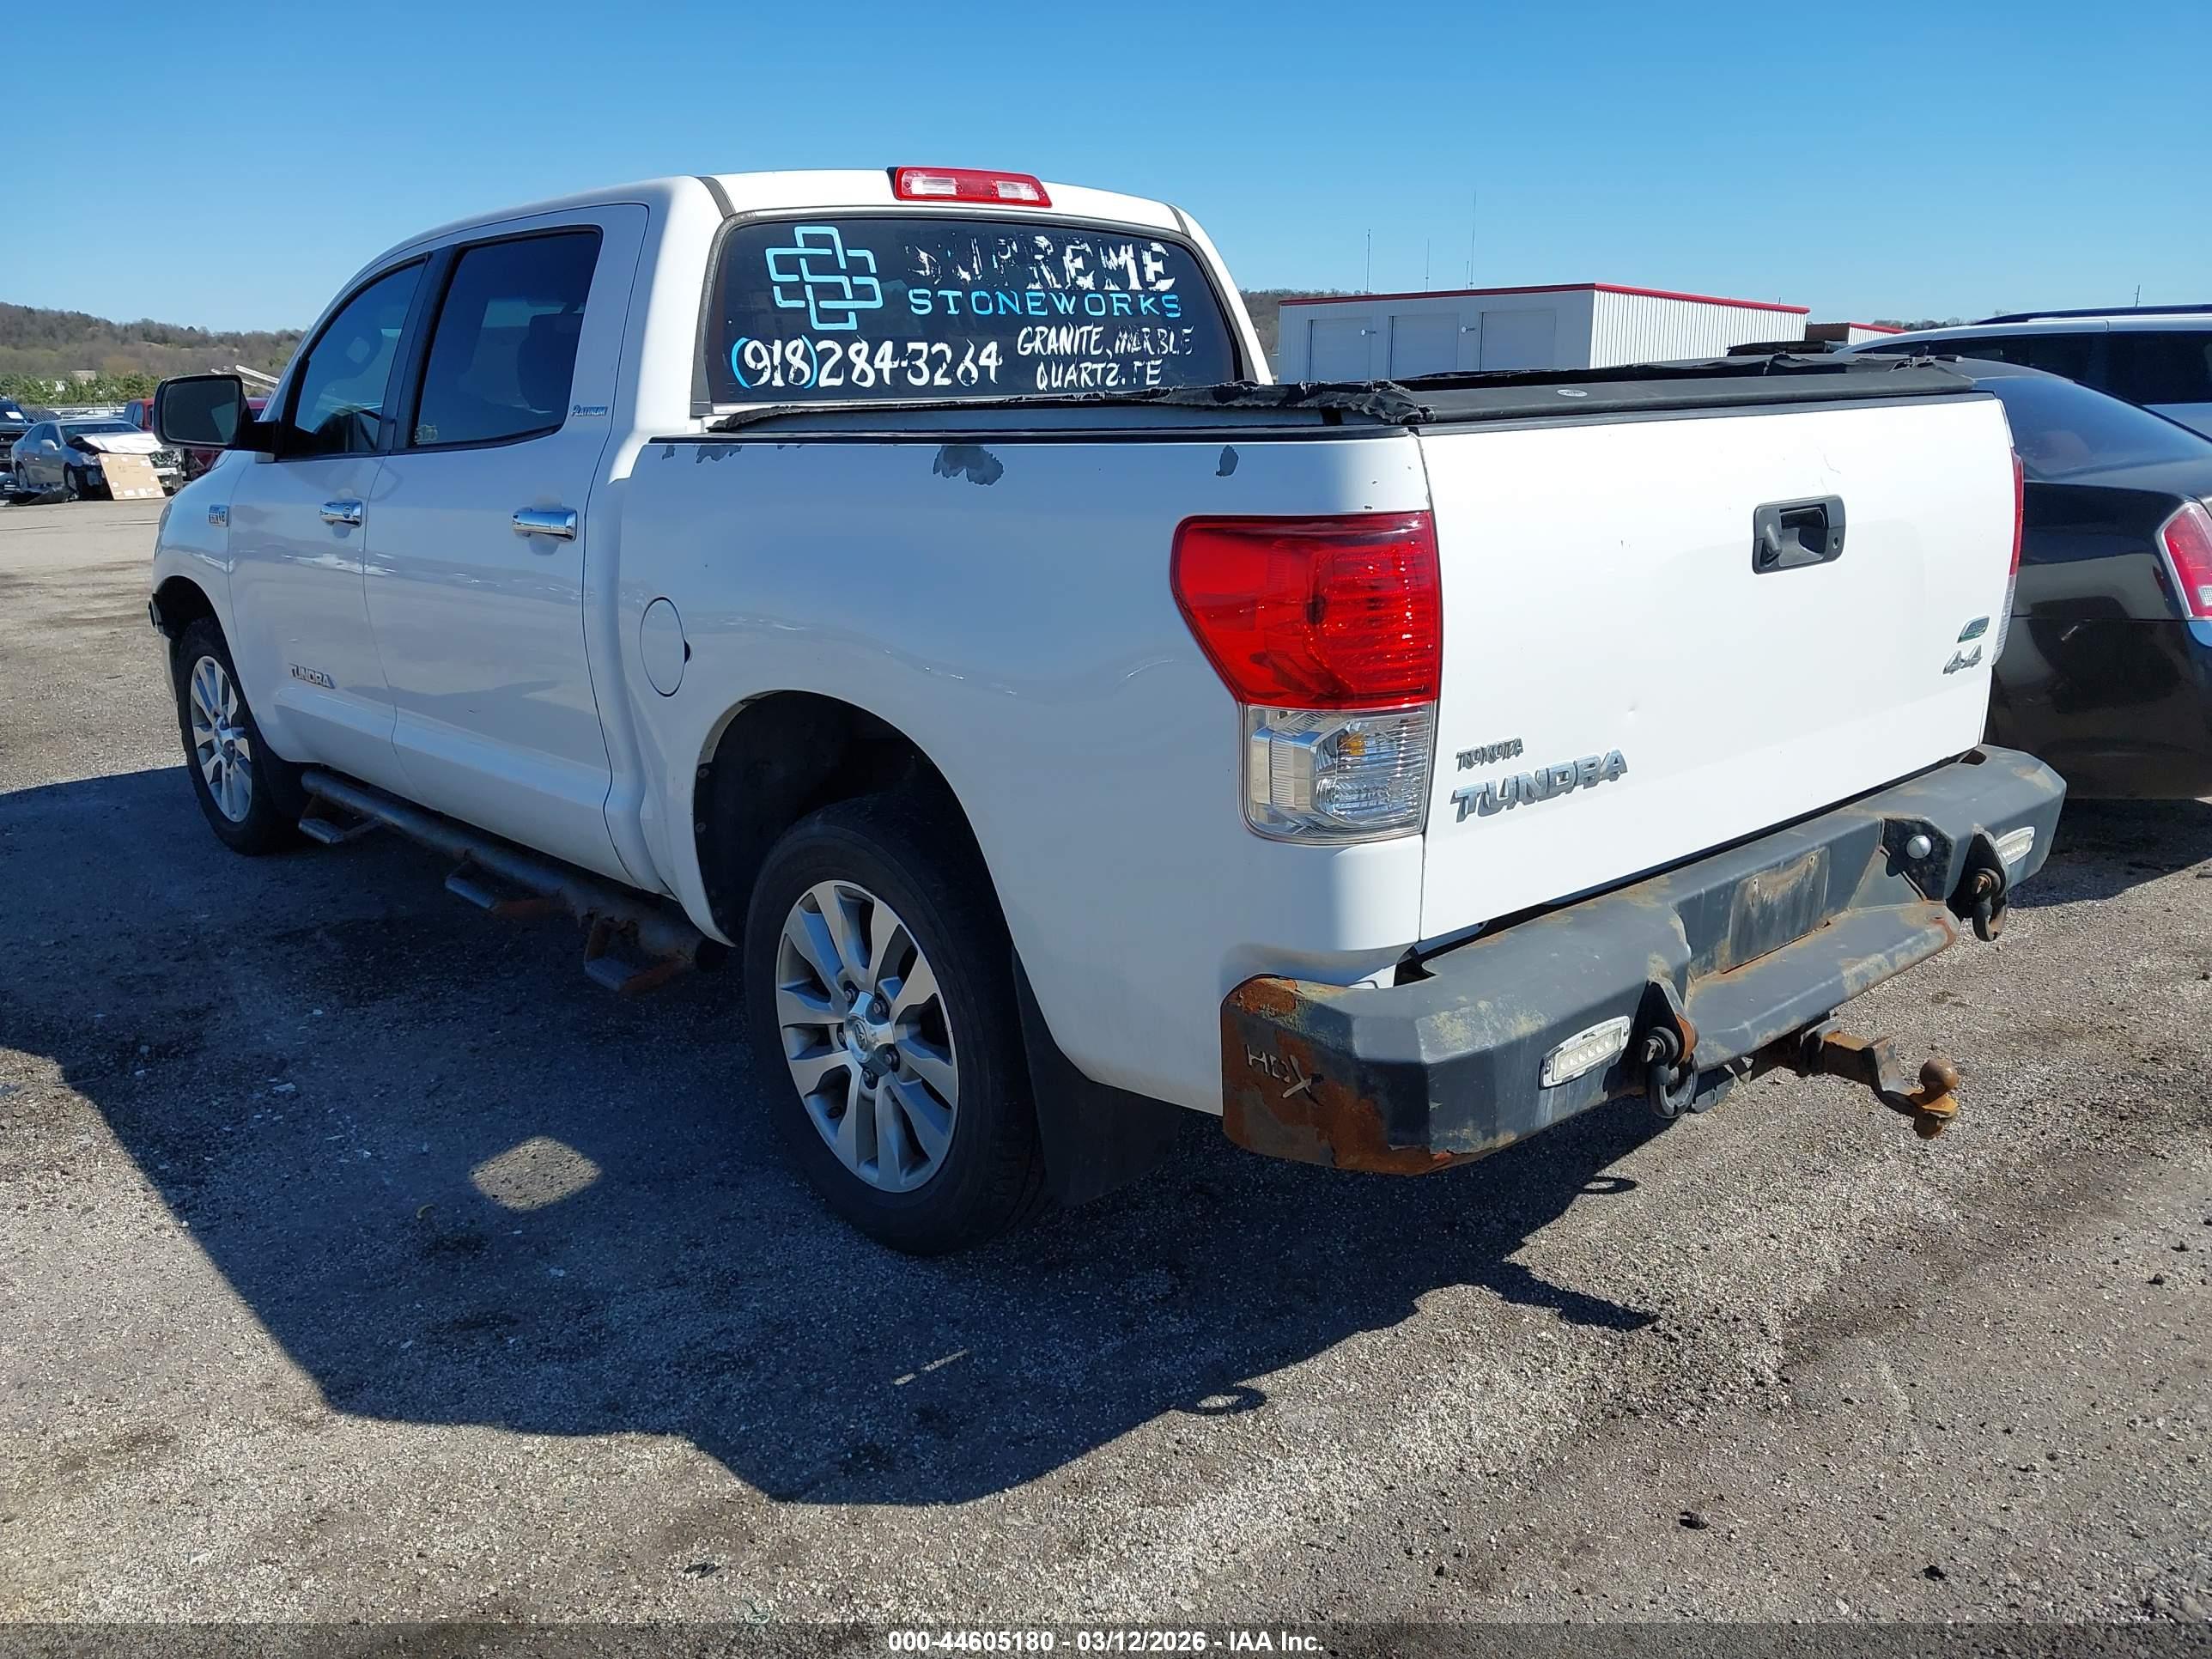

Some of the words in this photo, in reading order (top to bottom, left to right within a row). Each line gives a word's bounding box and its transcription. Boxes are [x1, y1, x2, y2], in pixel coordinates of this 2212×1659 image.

[908, 288, 1182, 318] STONEWORKS
[289, 662, 336, 690] TUNDRA
[1455, 738, 1523, 771] TOYOTA
[1449, 749, 1628, 823] TUNDRA
